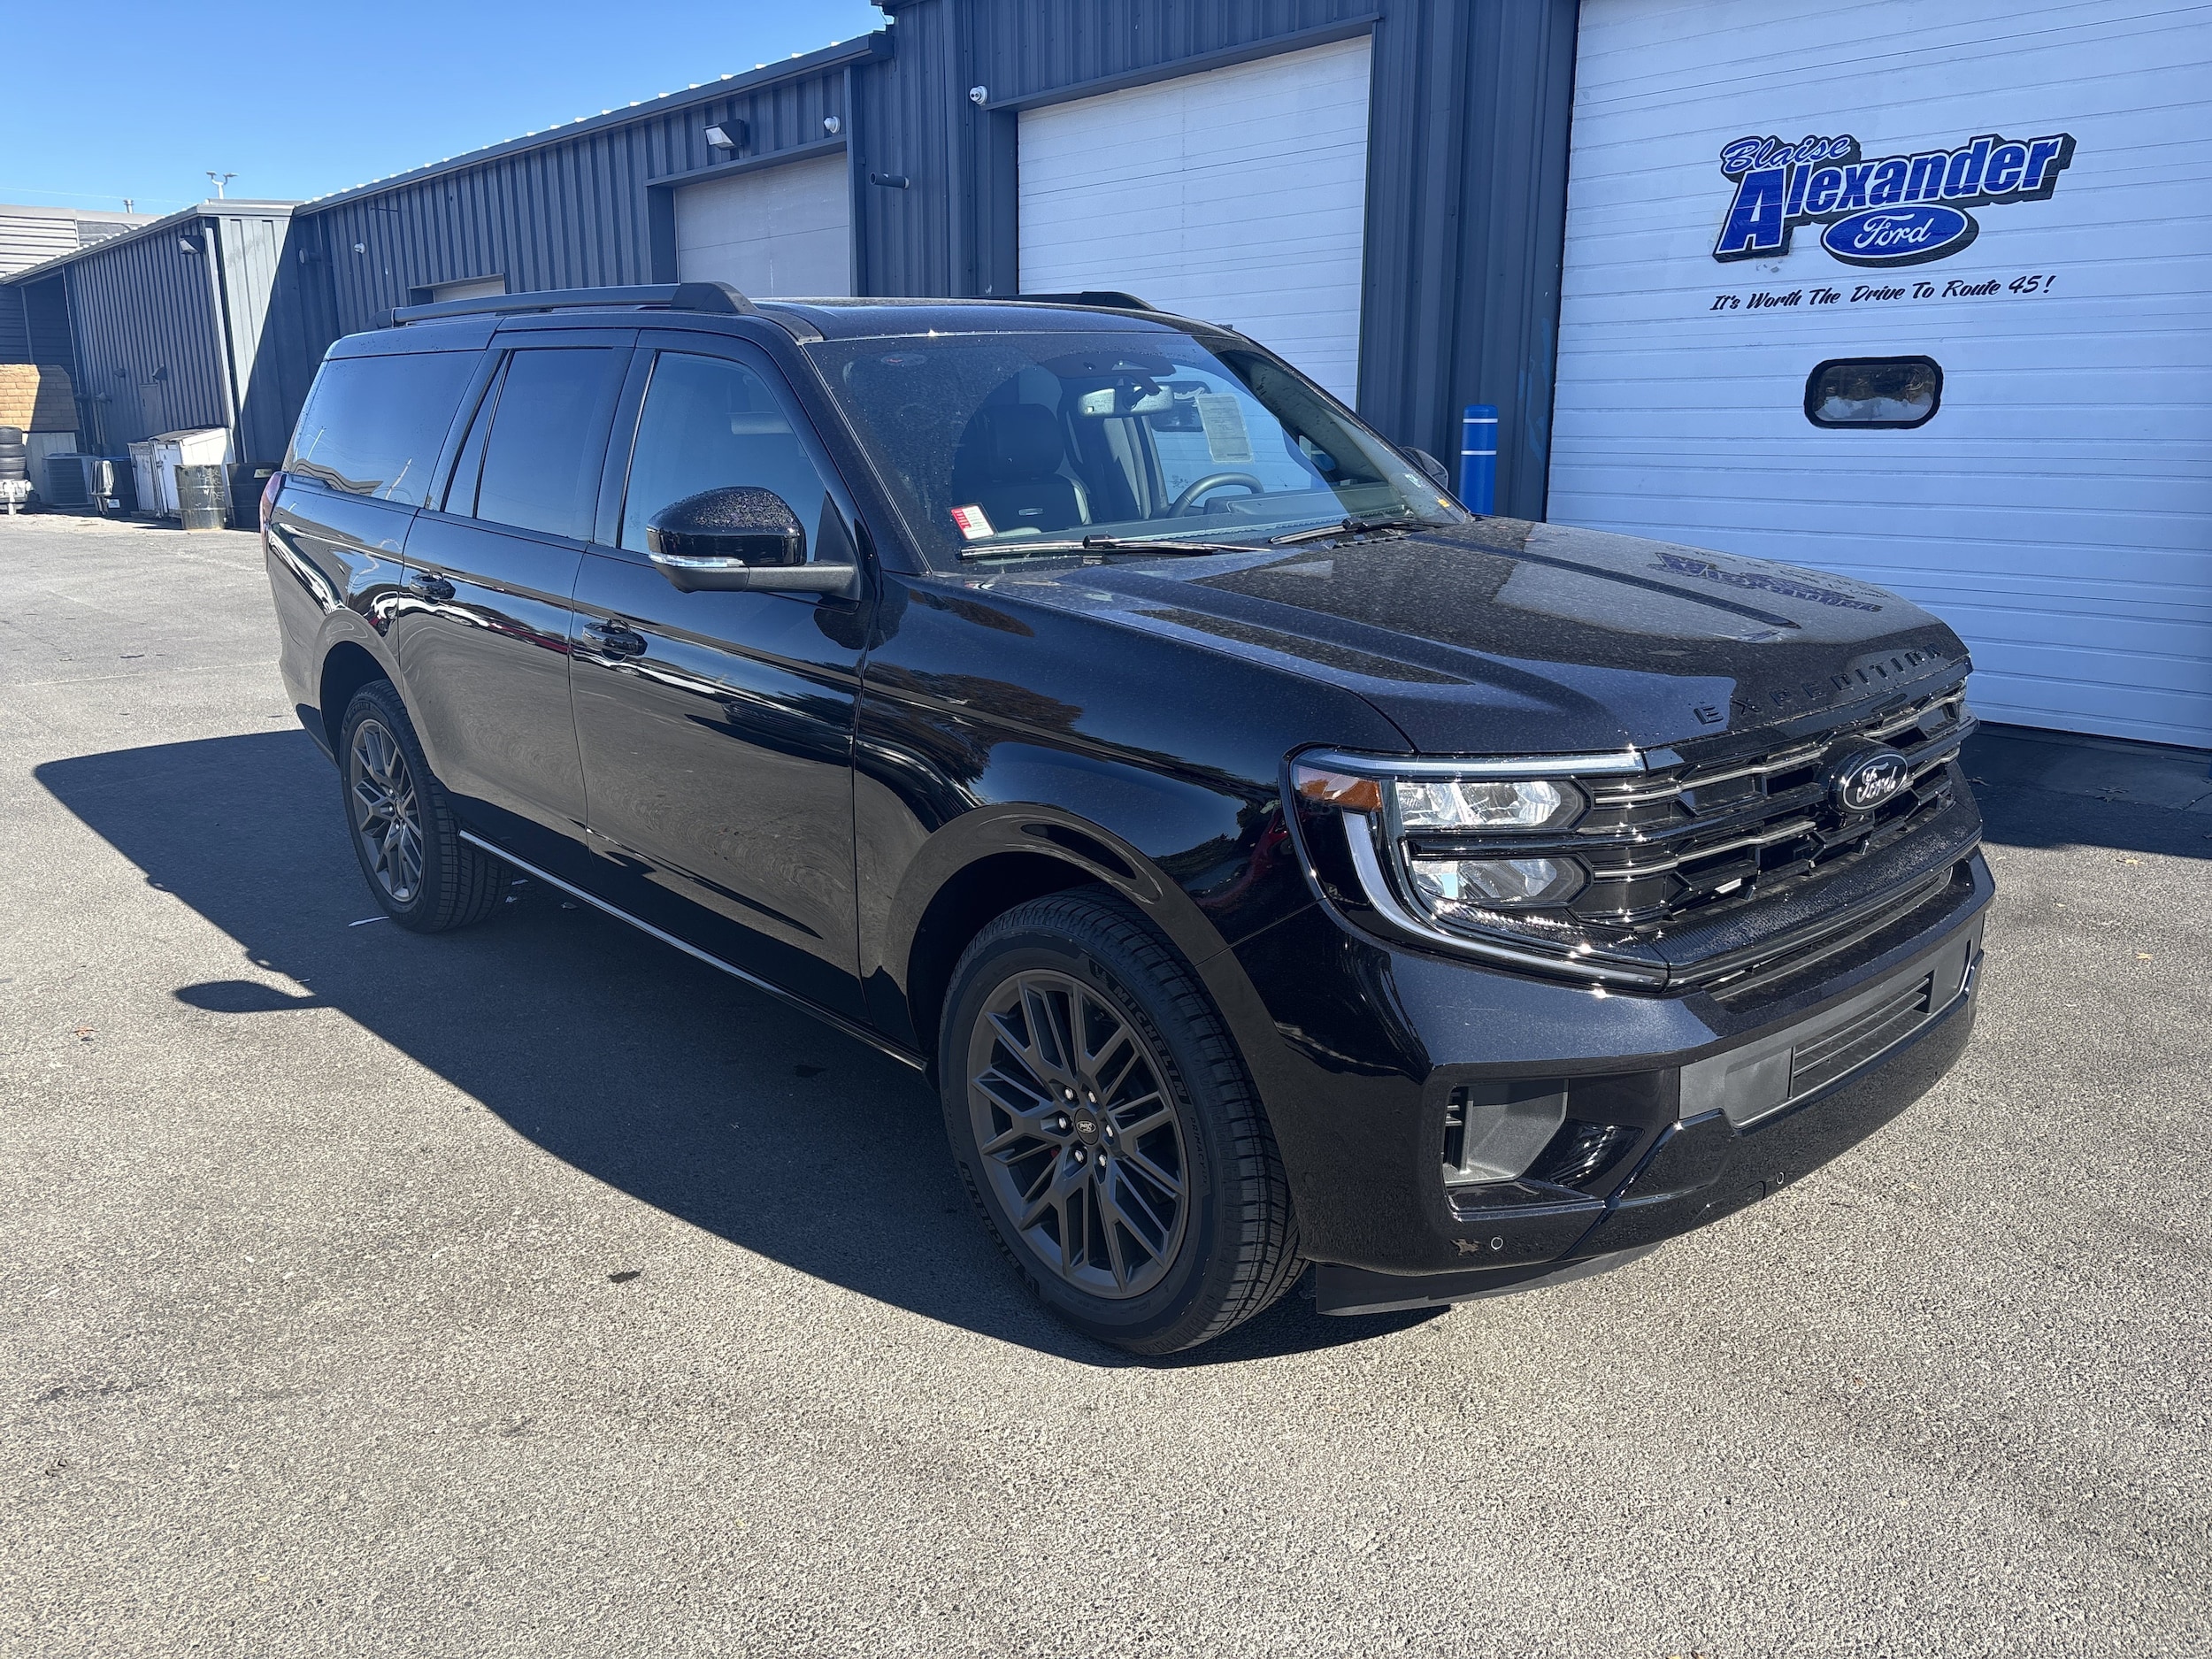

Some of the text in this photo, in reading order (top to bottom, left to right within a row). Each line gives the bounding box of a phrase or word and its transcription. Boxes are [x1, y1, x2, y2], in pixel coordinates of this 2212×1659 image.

[1723, 137, 1850, 173] Blaise
[1715, 135, 2065, 255] Alexander
[1854, 213, 1935, 249] Ford
[1709, 295, 1741, 311] It's
[1746, 289, 1802, 310] Worth
[1809, 287, 1841, 305] The
[1850, 285, 1906, 303] Drive
[1912, 281, 1935, 299] To
[1941, 279, 2001, 298] Route
[1856, 761, 1898, 803] Ford
[1113, 985, 1188, 1099] MICHELIN
[1189, 1116, 1207, 1169] PRIMACY
[961, 1165, 1019, 1269] MICHELIN
